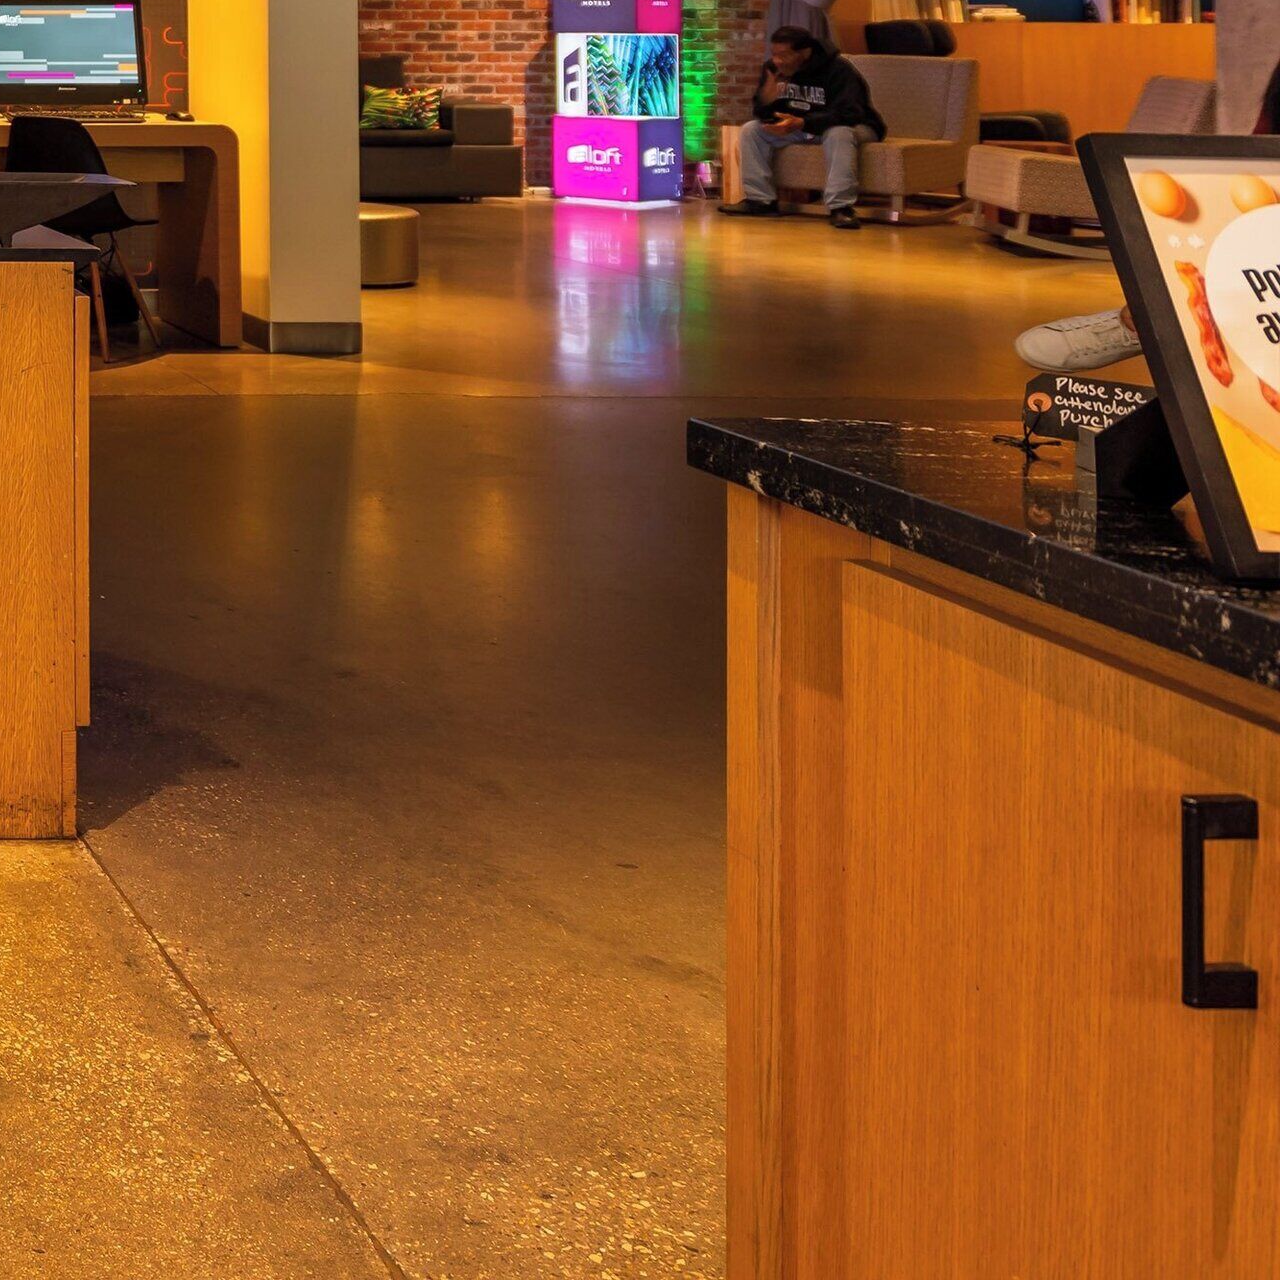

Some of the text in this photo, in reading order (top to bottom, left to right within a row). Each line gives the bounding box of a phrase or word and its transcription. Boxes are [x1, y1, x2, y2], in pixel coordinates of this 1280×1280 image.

[1241, 264, 1280, 303] Po
[1055, 377, 1147, 404] Please see
[1054, 395, 1137, 415] attendan
[1059, 409, 1113, 428] Purch
